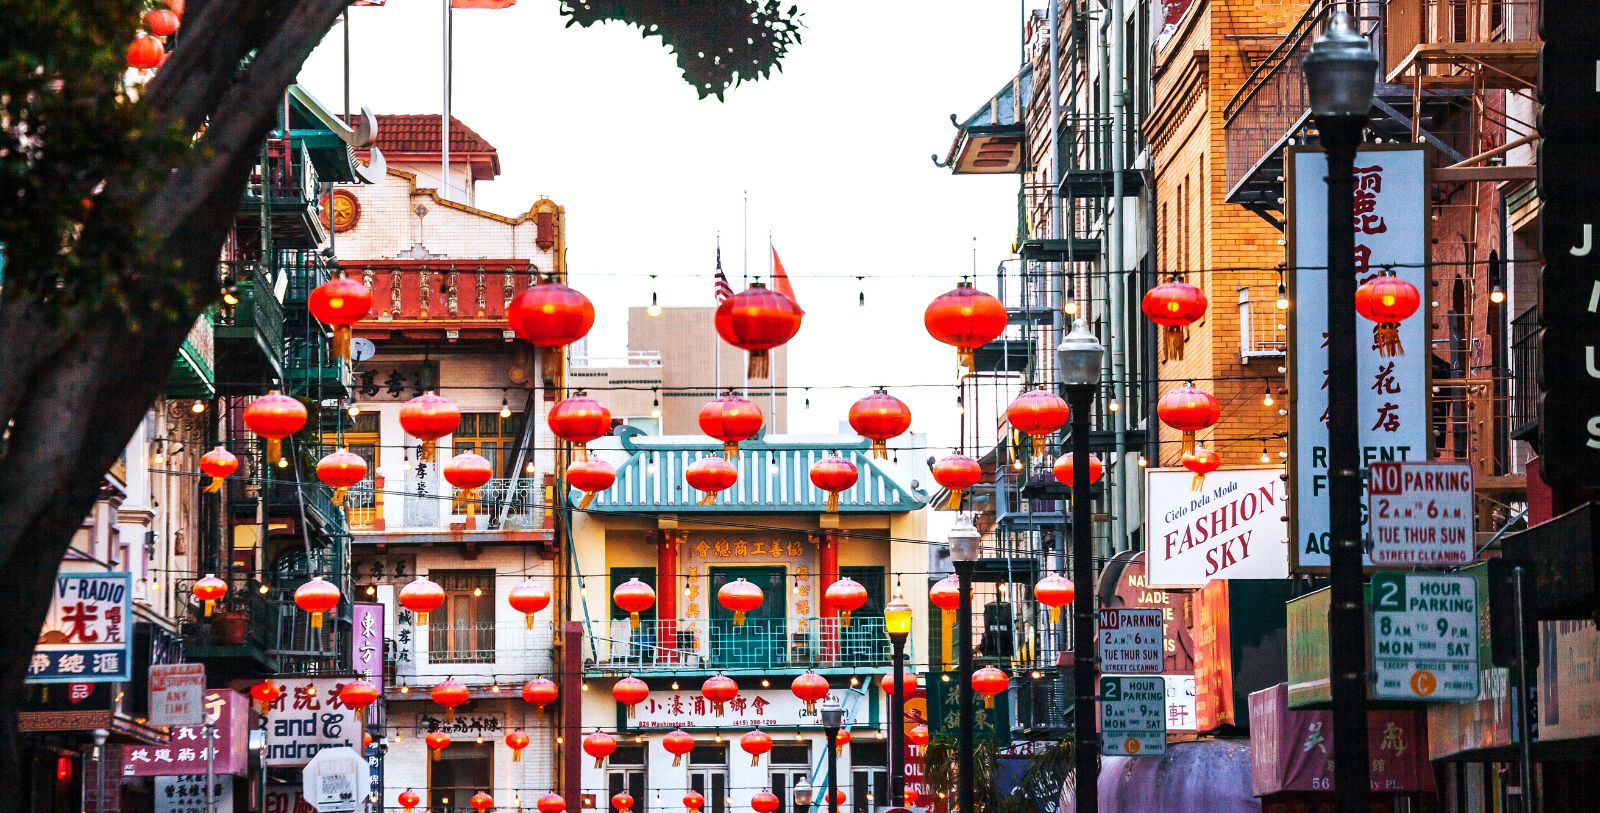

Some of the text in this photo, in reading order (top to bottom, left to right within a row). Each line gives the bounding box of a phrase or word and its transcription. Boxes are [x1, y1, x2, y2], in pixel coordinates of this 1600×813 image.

[1313, 446, 1411, 468] RENT
[1371, 466, 1398, 490] NO
[1405, 471, 1469, 492] PARKING
[1165, 481, 1238, 524] Cielo Dela Moda
[1379, 498, 1390, 518] 2
[1427, 499, 1438, 518] 6
[1164, 481, 1275, 561] FASHION
[1378, 526, 1465, 543] TUE THUR SUN
[1205, 529, 1252, 577] SKY
[1380, 550, 1466, 561] STREET CLEANING
[1138, 592, 1170, 604] JADE
[1380, 582, 1460, 606] 2 HOUR
[1410, 598, 1473, 612] PARKING
[61, 601, 98, 642] 光
[1100, 611, 1117, 627] NO
[1121, 614, 1161, 627] PARKING
[1380, 616, 1391, 636] 8
[1415, 623, 1428, 632] TO
[1437, 618, 1448, 638] 9
[1105, 632, 1112, 644] 2
[1135, 633, 1142, 644] 6
[1104, 650, 1158, 661] TUE THUR SUN
[1379, 641, 1413, 655] MON
[1447, 643, 1469, 657] SAT
[1105, 664, 1159, 672] STREET CLEANING
[167, 691, 188, 702] ANY
[1105, 682, 1116, 698] 2
[1129, 682, 1155, 691] HOUR
[1123, 692, 1163, 701] PARKING
[165, 703, 190, 714] TIME
[1106, 705, 1113, 717] 8
[1140, 705, 1147, 717] 9
[274, 713, 317, 736] and
[1104, 720, 1126, 728] MON
[1146, 720, 1161, 729] SAT
[1312, 778, 1330, 790] 56
